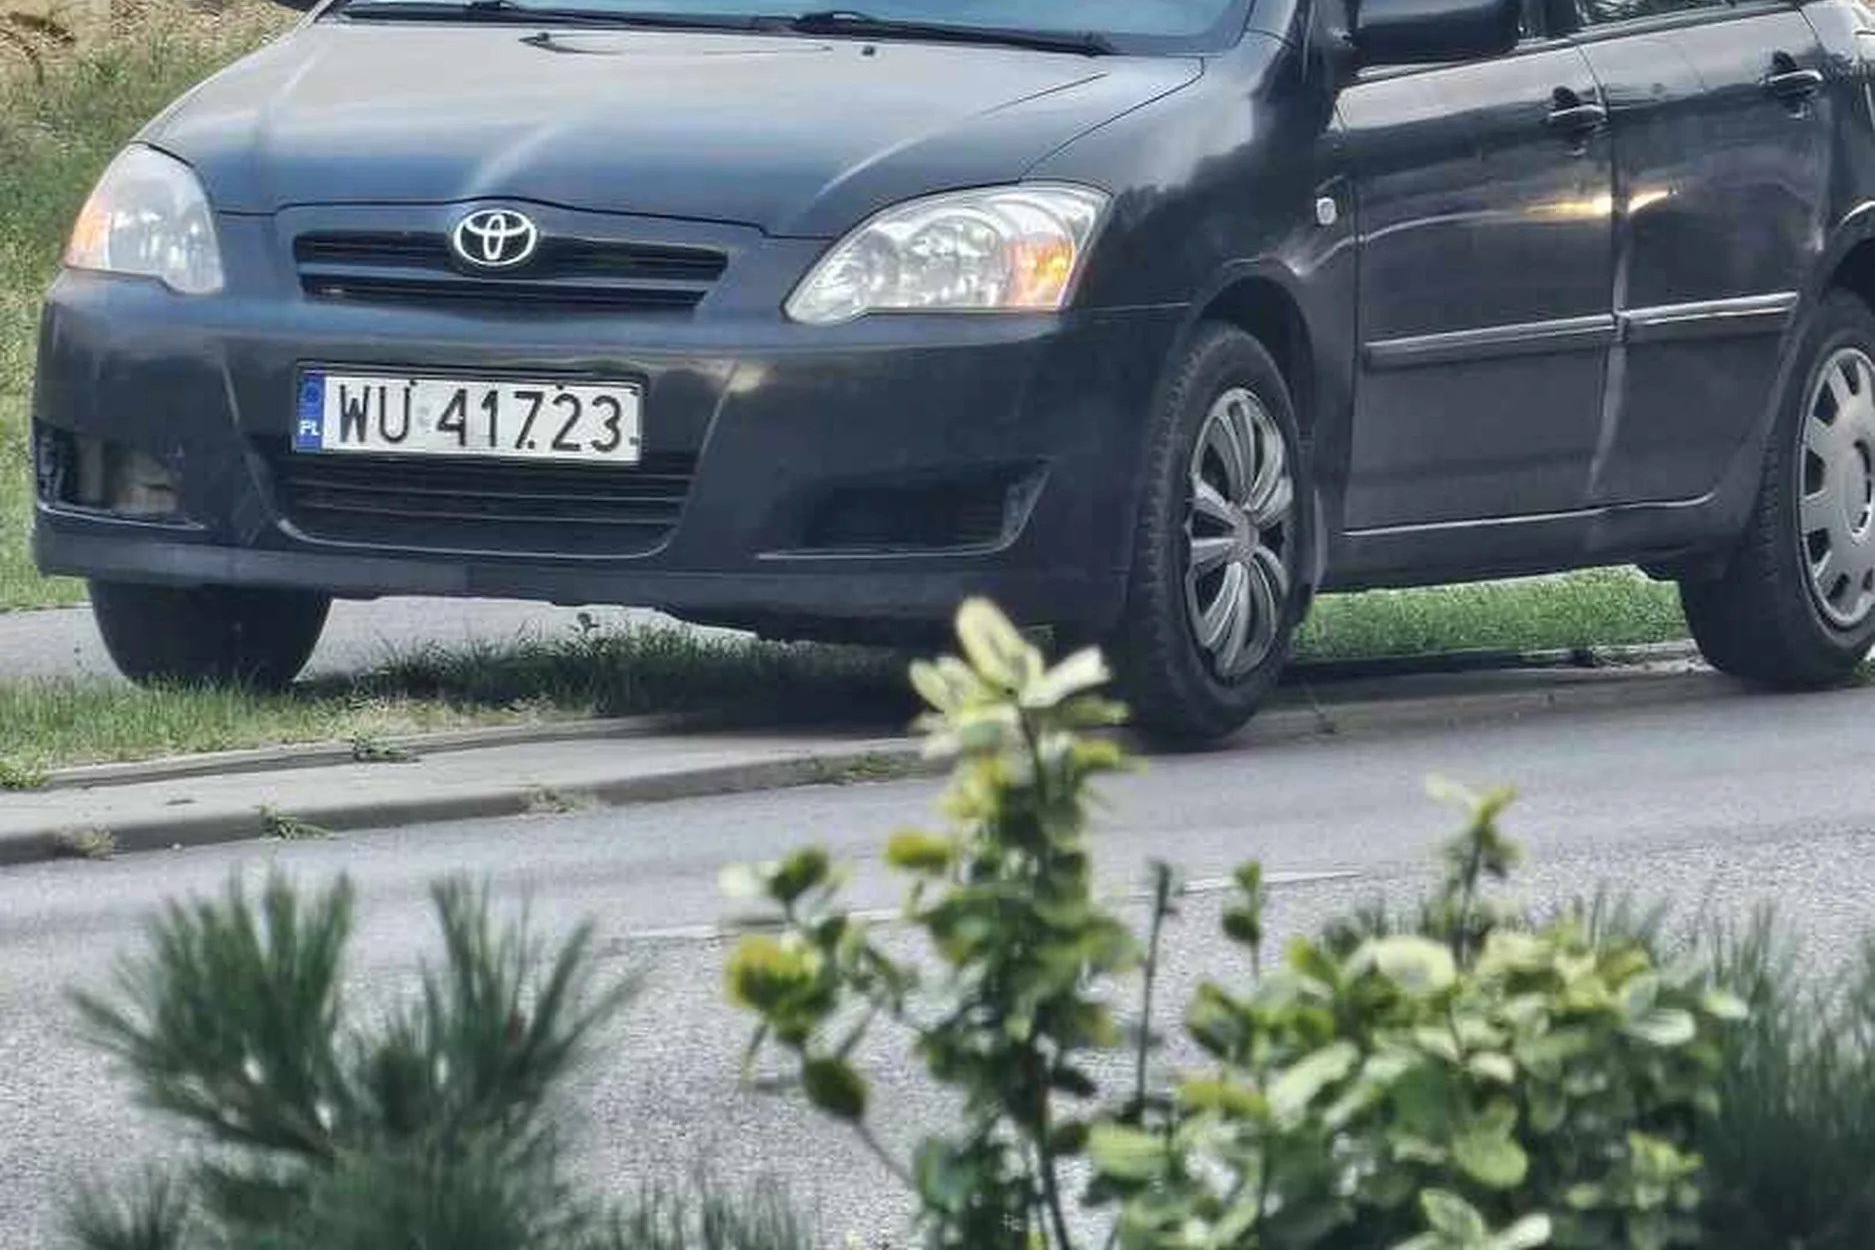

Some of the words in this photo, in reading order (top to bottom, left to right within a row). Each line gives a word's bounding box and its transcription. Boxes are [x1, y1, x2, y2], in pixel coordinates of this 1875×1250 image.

[300, 420, 320, 436] PL
[339, 384, 411, 444] WU
[436, 388, 622, 453] 41723
